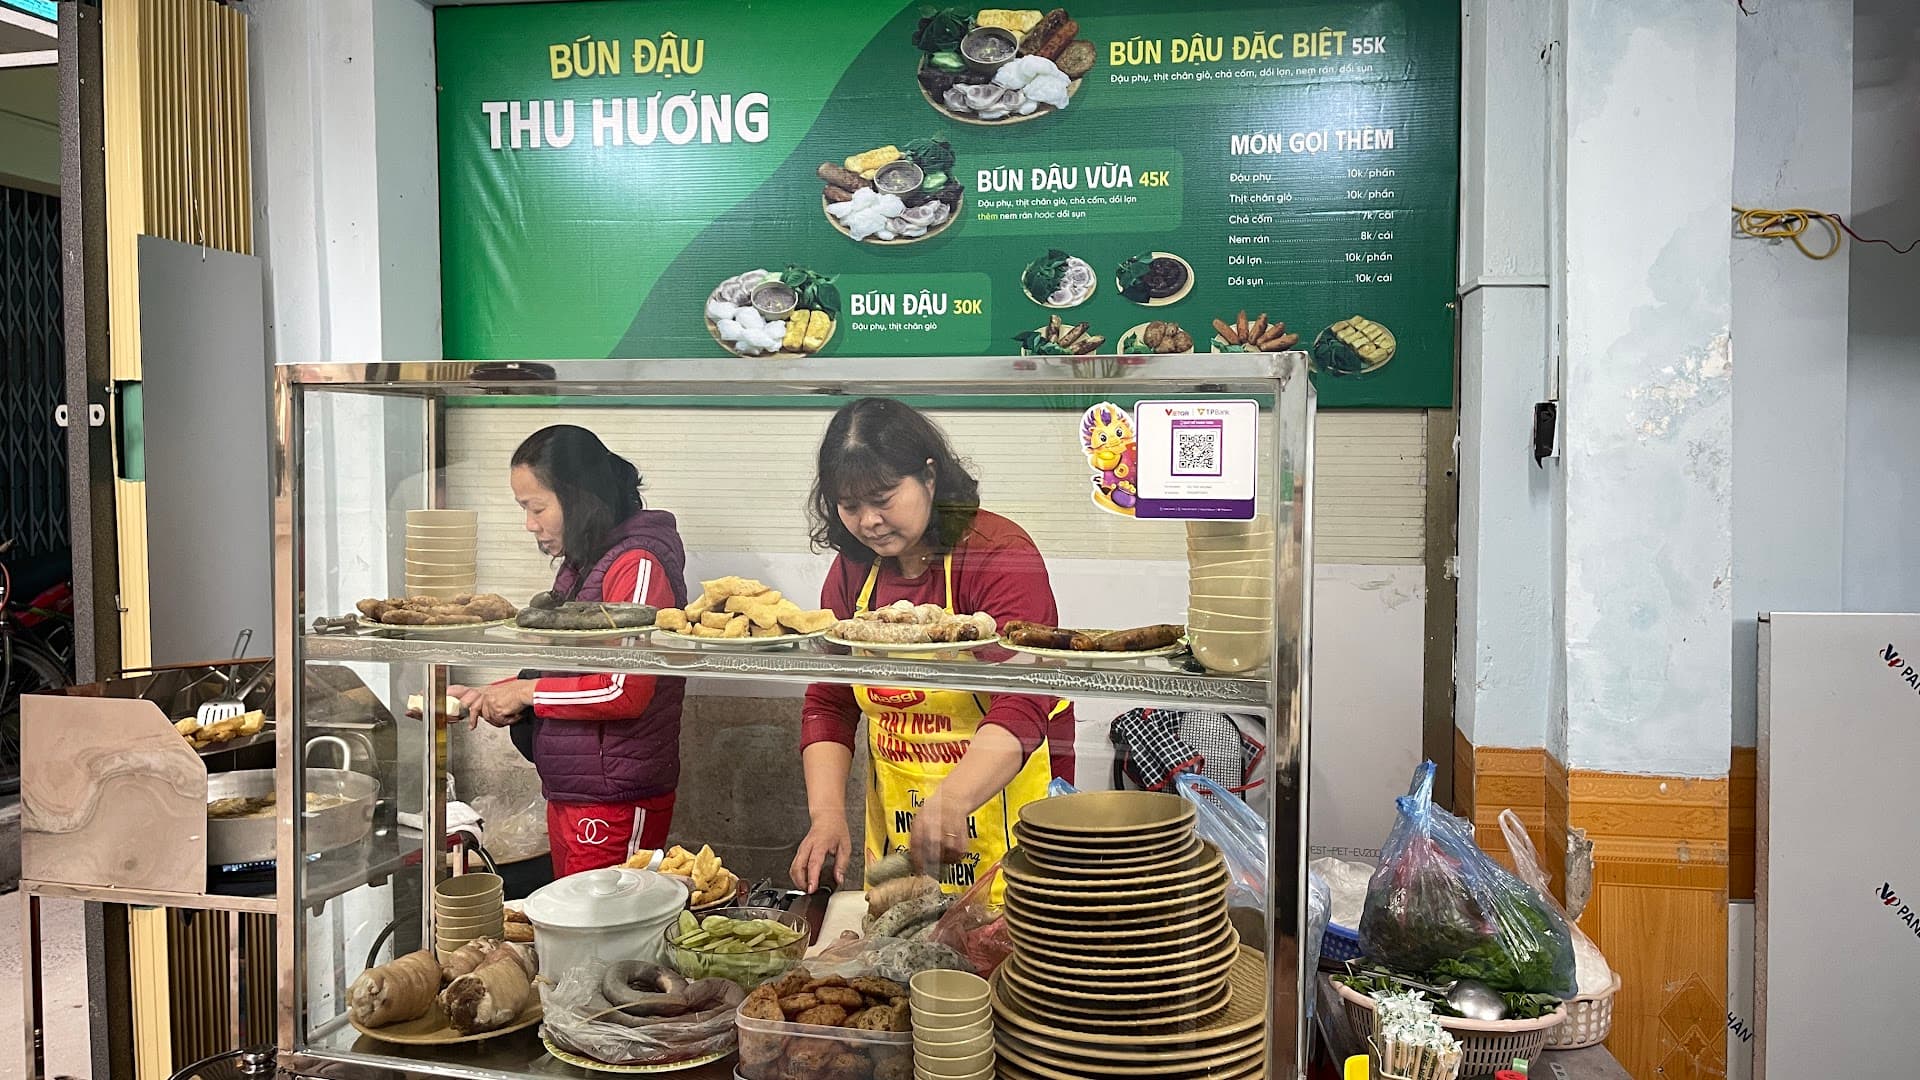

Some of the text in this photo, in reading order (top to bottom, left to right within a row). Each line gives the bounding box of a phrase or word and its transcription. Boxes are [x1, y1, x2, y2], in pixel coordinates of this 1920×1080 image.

[1109, 26, 1386, 66] BÚN ĐẬU ĐẶC BIỆT 55K
[549, 31, 705, 79] BÚN ĐẬU
[1110, 73, 1129, 84] Đậu
[1131, 73, 1151, 84] phụ,
[1153, 72, 1169, 83] thịt
[1171, 71, 1194, 81] chân
[1295, 67, 1316, 76] nem
[482, 90, 769, 149] THU HƯƠNG
[1231, 125, 1394, 156] MÓN GỌI THÊM
[977, 161, 1170, 193] BÚN ĐẬU VỪA 45K
[1229, 173, 1250, 184] Đậu
[1252, 172, 1272, 184] phụ
[977, 199, 995, 209] Đậu
[1015, 198, 1030, 208] thịt
[1229, 194, 1248, 205] Thịt
[1000, 212, 1018, 220] nem
[1228, 230, 1393, 244] Nem rán 8k/cái
[1246, 277, 1264, 288] sụn
[1355, 273, 1393, 283] 10k/cái
[850, 289, 982, 318] BÚN ĐẬU 30K
[852, 322, 868, 331] Đậu
[889, 322, 902, 331] thịt
